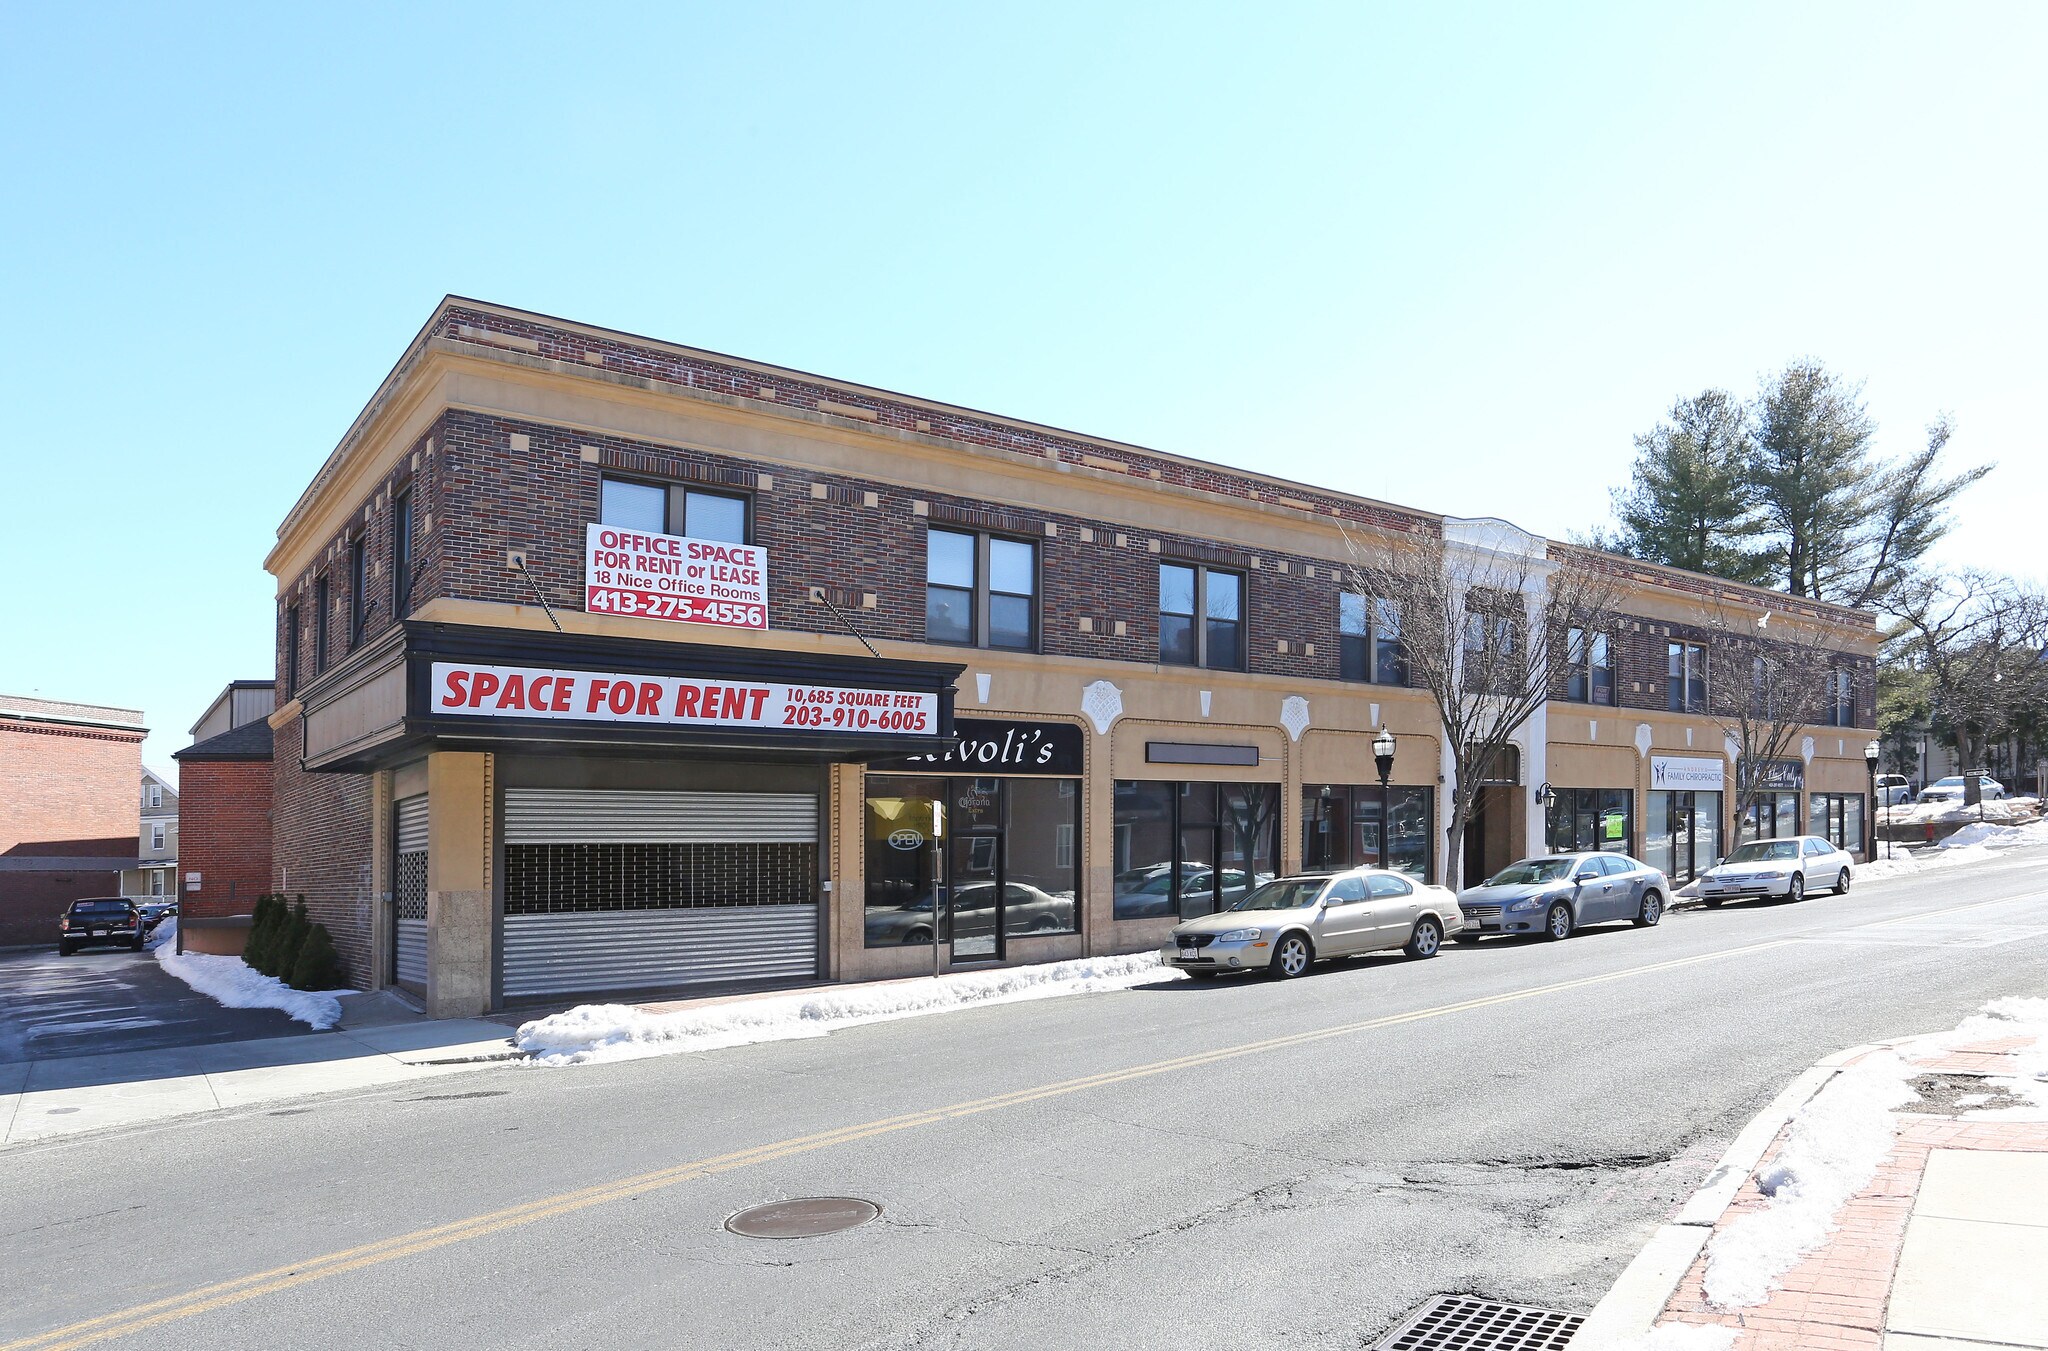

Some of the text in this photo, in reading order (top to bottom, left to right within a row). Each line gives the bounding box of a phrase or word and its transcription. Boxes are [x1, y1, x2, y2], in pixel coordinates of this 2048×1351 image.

[600, 530, 756, 567] OFFICE SPACE
[594, 550, 760, 586] FOR RENT or LEASE
[594, 570, 761, 601] 18 Nice Office Rooms
[591, 589, 762, 626] 413-275-4556
[441, 670, 770, 721] SPACE FOR RENT
[787, 688, 922, 709] 10,685 SQUARE FEET
[782, 705, 927, 731] 203-910-6005
[907, 728, 1054, 764] voli's
[1667, 772, 1722, 782] FAMILY CHIROPRACTIC
[958, 796, 990, 808] Corona
[890, 834, 920, 846] OPEN
